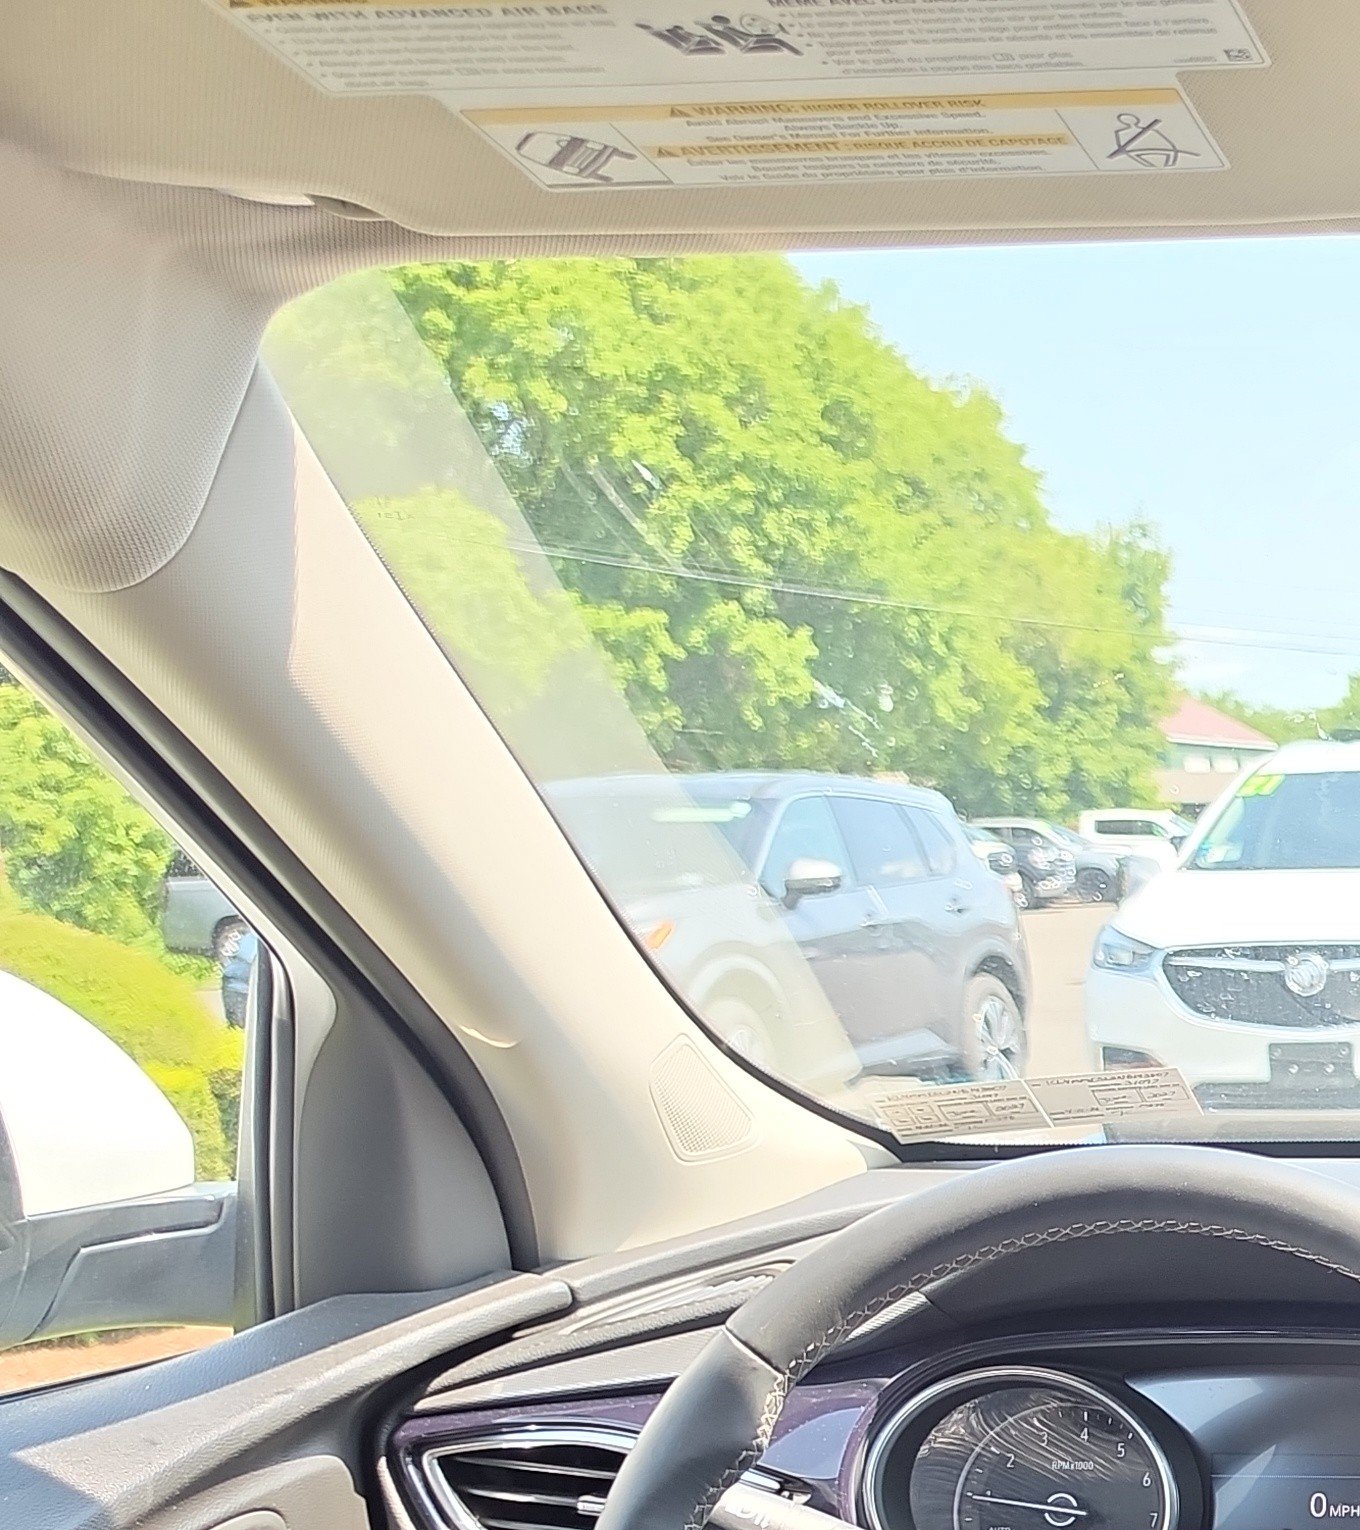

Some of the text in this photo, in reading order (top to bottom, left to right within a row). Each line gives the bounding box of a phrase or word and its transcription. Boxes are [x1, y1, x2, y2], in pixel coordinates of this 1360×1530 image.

[375, 8, 494, 19] ADVANCED
[501, 7, 541, 17] AIR
[947, 98, 985, 108] RISK
[985, 136, 1069, 147] CAPOTAGE
[1041, 1431, 1049, 1446] 3
[1080, 1427, 1090, 1443] 4
[1116, 1442, 1125, 1458] 5
[1006, 1453, 1015, 1468] 2
[1142, 1472, 1151, 1487] 6
[1309, 1492, 1360, 1518] 0 MPH
[1149, 1513, 1158, 1528] 7
